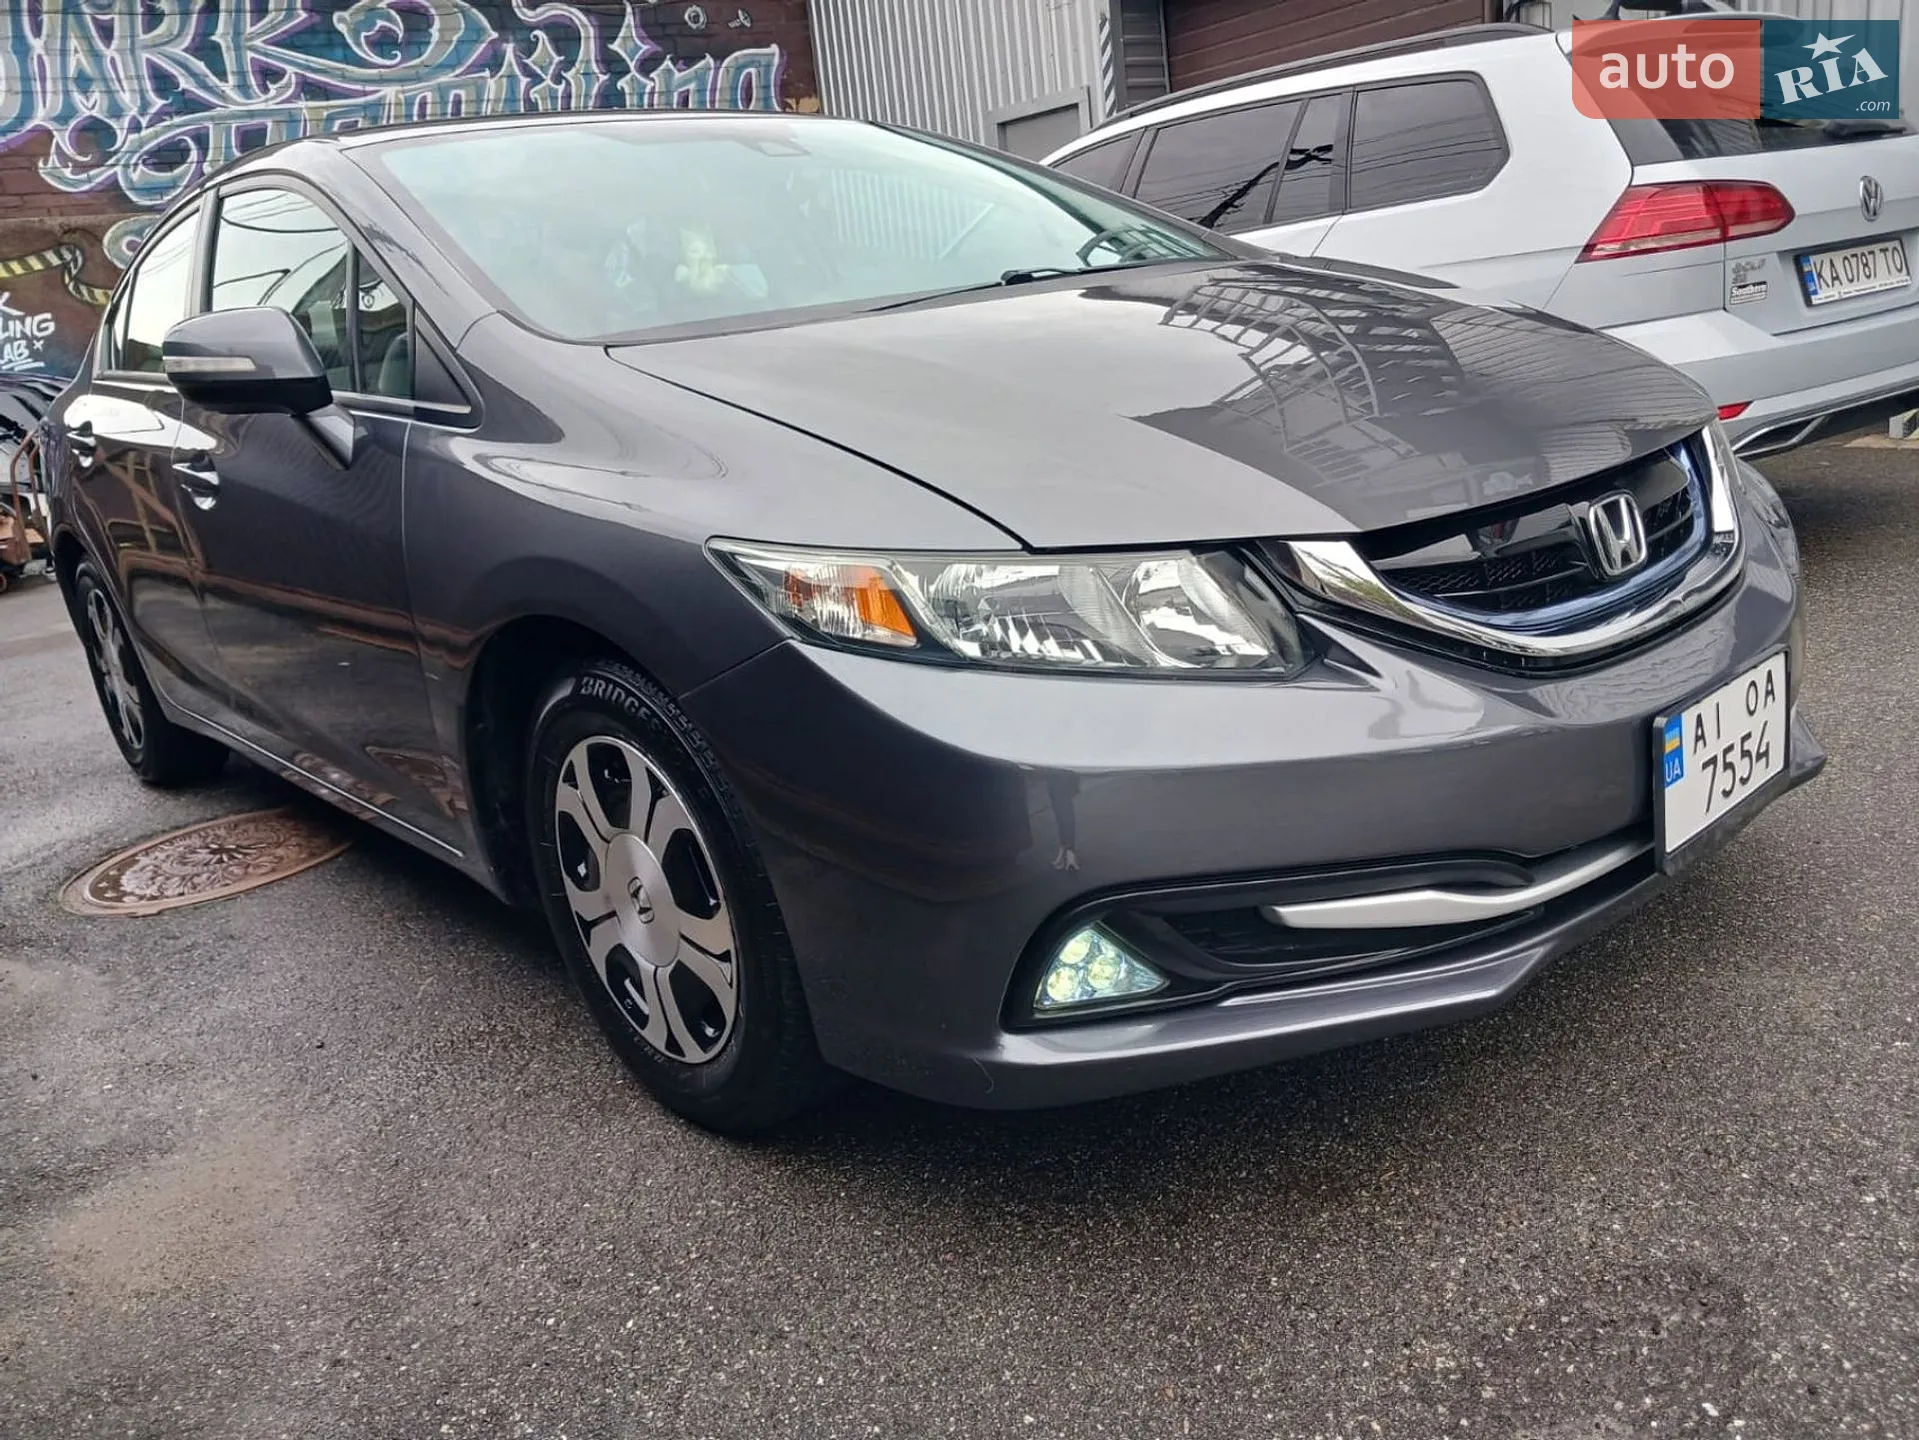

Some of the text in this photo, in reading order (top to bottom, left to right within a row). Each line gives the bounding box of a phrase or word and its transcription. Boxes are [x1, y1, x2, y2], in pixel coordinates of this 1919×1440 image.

[1813, 257, 1843, 290] KA
[1842, 250, 1877, 284] 0787
[1879, 246, 1903, 275] TO
[1692, 668, 1776, 755] AI OA
[1665, 757, 1682, 782] UA
[1701, 719, 1771, 815] 7554
